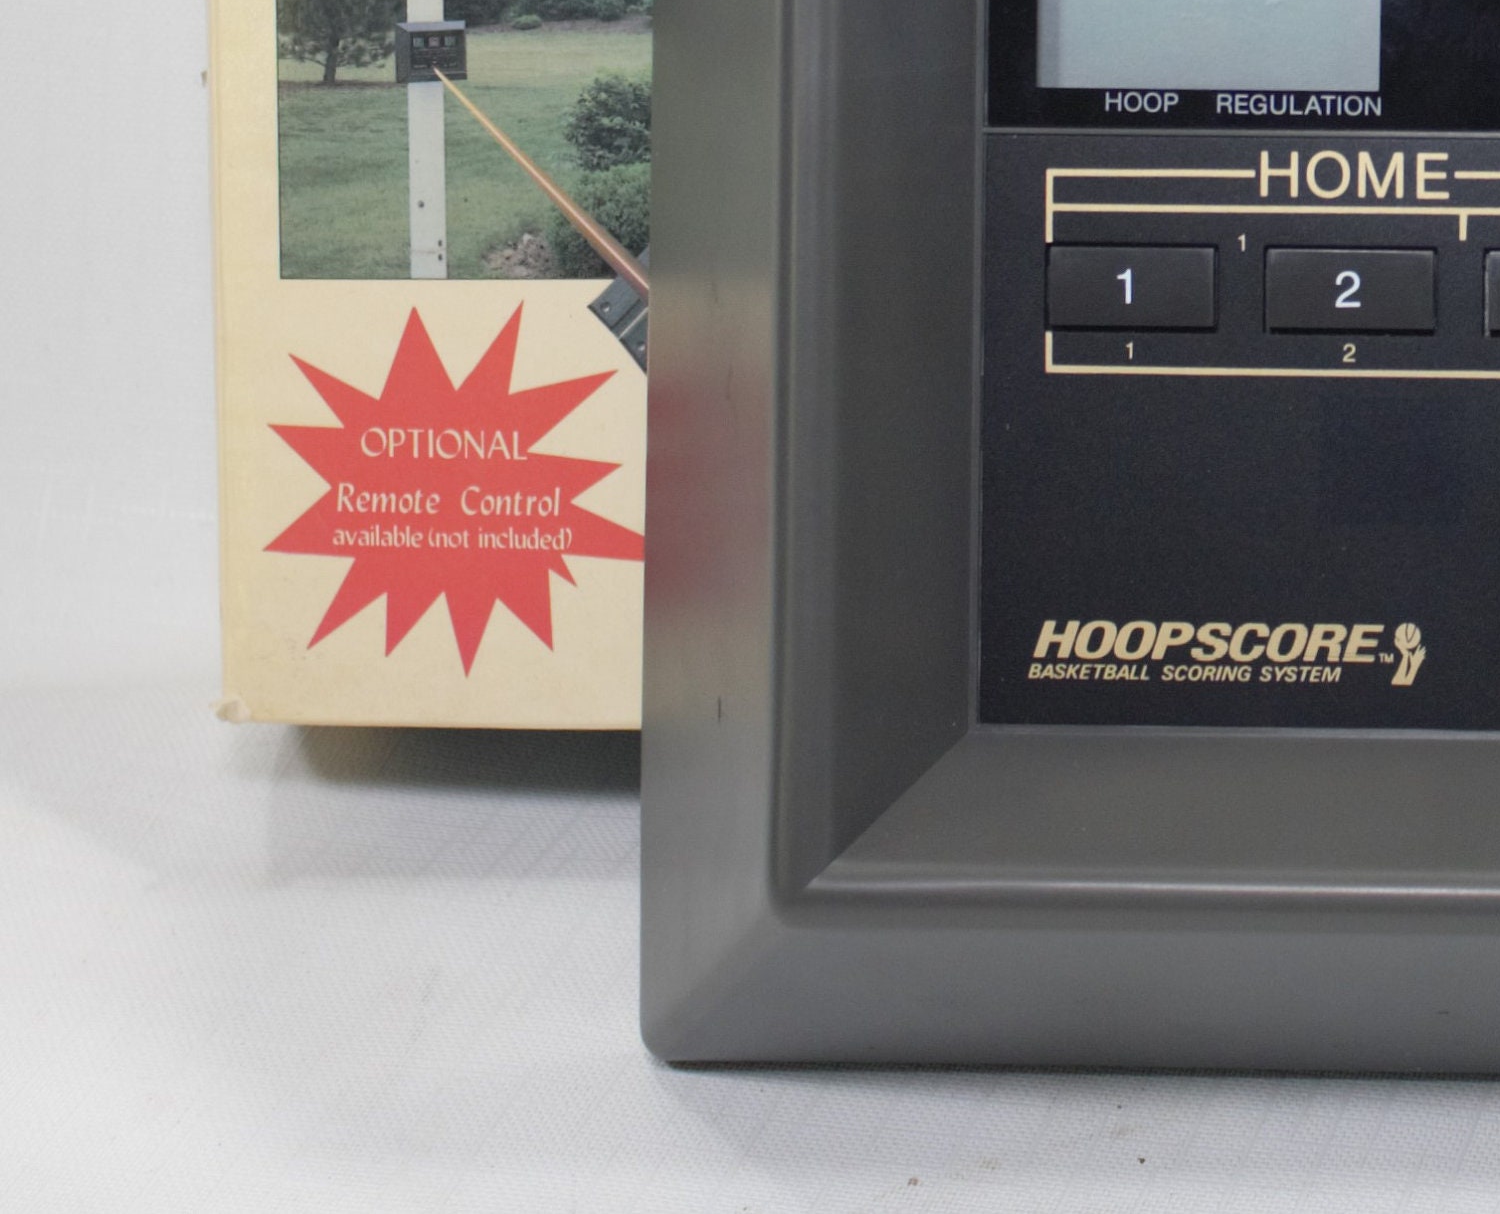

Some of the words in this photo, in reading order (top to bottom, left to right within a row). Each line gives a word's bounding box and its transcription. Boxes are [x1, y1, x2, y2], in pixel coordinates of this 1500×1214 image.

[1104, 92, 1179, 114] HOOP
[1216, 94, 1383, 117] REGULATION
[1258, 150, 1450, 201] HOME
[1236, 234, 1248, 253] 1
[1115, 268, 1134, 305] 1
[1334, 270, 1362, 308] 2
[1124, 341, 1135, 360] 1
[1342, 343, 1357, 363] 2
[360, 427, 528, 461] OPTIONAL
[336, 482, 441, 515] Remote
[460, 485, 561, 517] Control
[332, 524, 424, 549] available
[428, 527, 470, 549] (not
[478, 527, 573, 551] included)
[1032, 620, 1385, 664] HOOPSCORE
[1028, 664, 1151, 682] BASKETBALL
[1161, 665, 1252, 683] SCORING
[1259, 666, 1342, 683] SYSTEM
